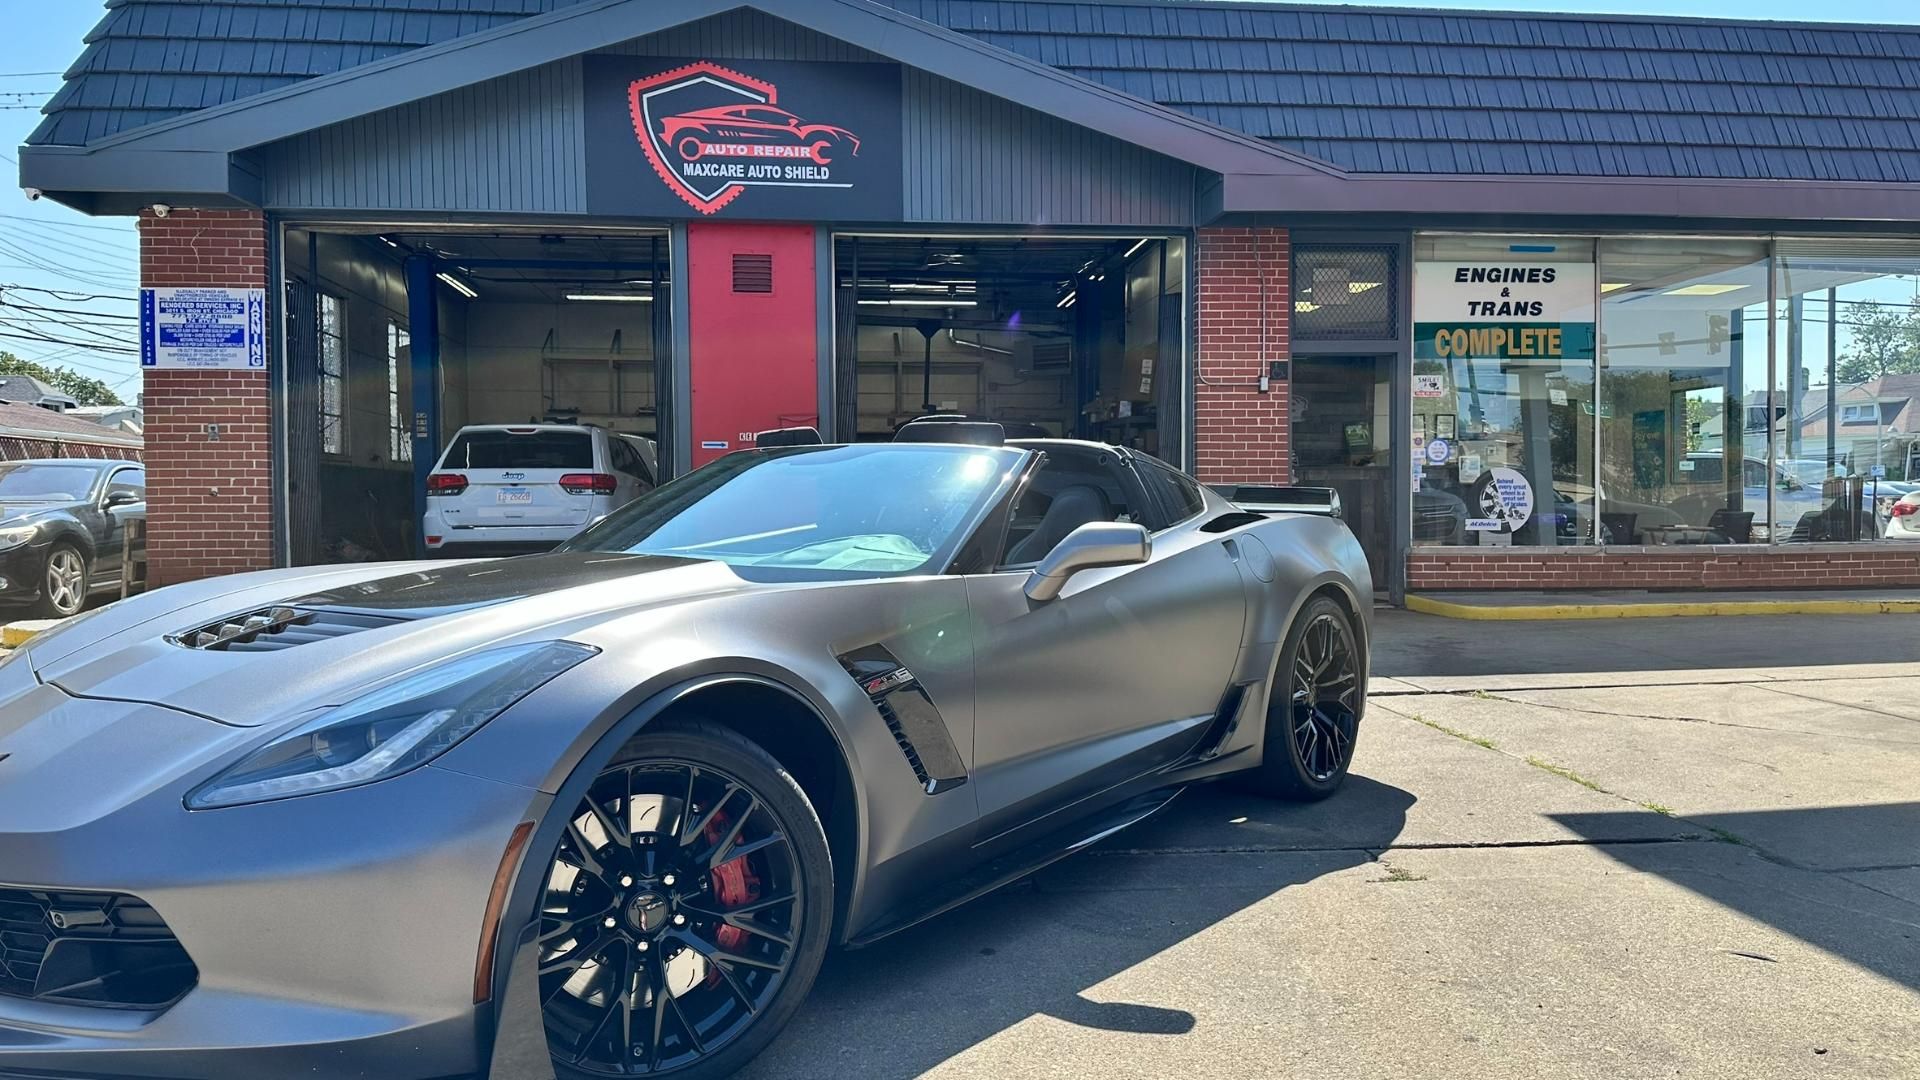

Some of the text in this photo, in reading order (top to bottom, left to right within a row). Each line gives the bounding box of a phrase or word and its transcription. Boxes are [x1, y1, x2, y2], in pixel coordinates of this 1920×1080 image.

[705, 145, 811, 157] AUTO REPAIR
[683, 163, 830, 180] MAXCARE AUTO SHIELD
[1454, 267, 1556, 283] ENGINES
[1500, 287, 1510, 298] &
[1467, 301, 1543, 316] TRANS
[248, 291, 263, 366] WARNING
[1434, 328, 1562, 357] COMPLETE
[502, 471, 525, 480] Jeep
